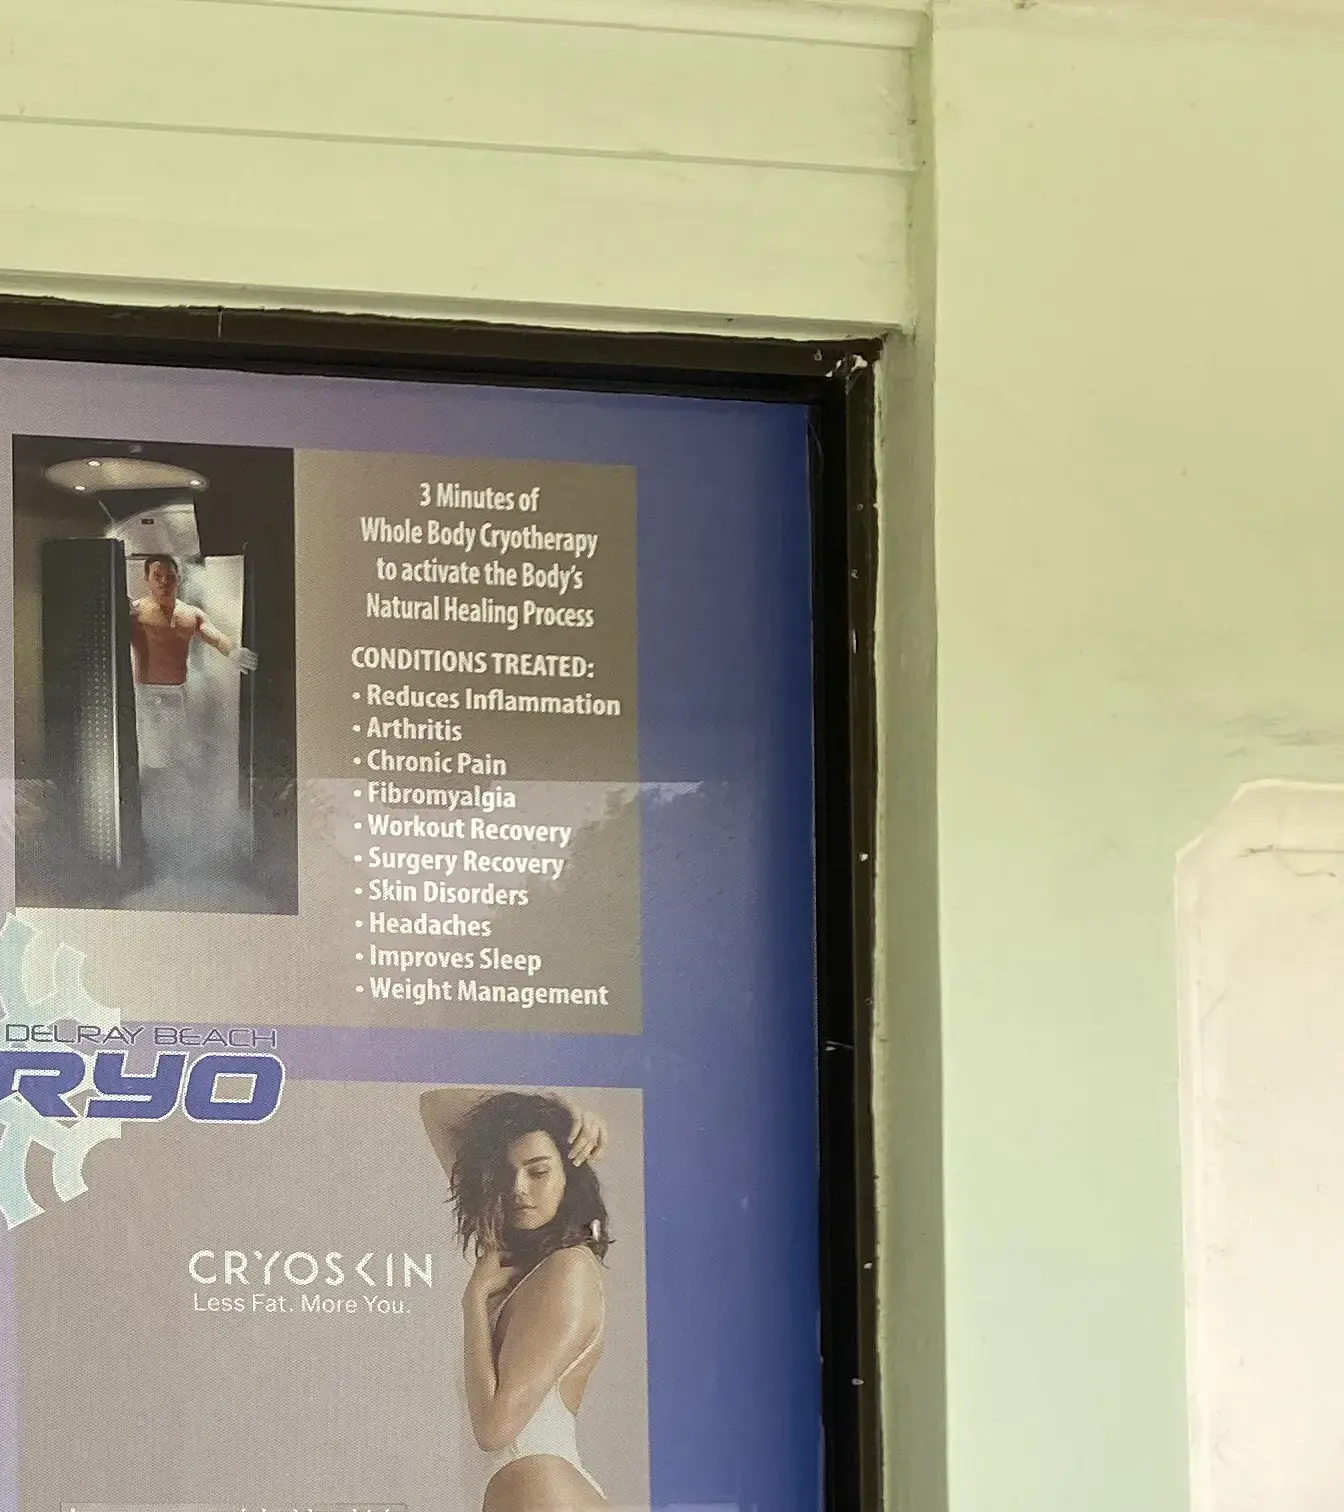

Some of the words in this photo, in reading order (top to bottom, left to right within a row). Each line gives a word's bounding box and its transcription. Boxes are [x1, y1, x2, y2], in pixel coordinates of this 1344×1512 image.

[420, 482, 431, 506] 3
[437, 482, 514, 510] Minutes
[361, 516, 422, 544] Whole
[428, 520, 475, 553] Body
[480, 522, 599, 558] Cryotherapy
[402, 558, 480, 585] activate
[484, 560, 517, 586] the
[366, 593, 439, 621] Natural
[444, 596, 519, 631] Healing
[523, 600, 594, 628] Process
[351, 646, 487, 673] CONDITIONS
[492, 653, 595, 678] TREATED:
[367, 683, 460, 710] Reduces
[465, 687, 621, 716] Inflammation
[366, 717, 462, 741] Arthritis
[367, 750, 452, 773] Chronic
[457, 752, 507, 775] Pain
[368, 781, 516, 813] Fibromyalgia
[368, 814, 465, 838] Workout
[471, 818, 572, 847] Recovery
[369, 847, 457, 876] Surgery
[463, 850, 565, 880] Recovery
[369, 879, 416, 902] Skin
[424, 881, 528, 906] Disorders
[370, 912, 492, 937] Headaches
[370, 944, 474, 972] Improves
[480, 947, 542, 975] Sleep
[370, 977, 451, 1005] Weight
[457, 979, 609, 1009] Management
[5, 1023, 145, 1045] DELRAY
[154, 1028, 277, 1048] BEACH
[189, 1250, 432, 1288] CRYOSKIN
[194, 1292, 244, 1311] Less
[252, 1294, 293, 1312] Fat.
[302, 1294, 358, 1312] More
[363, 1295, 411, 1314] You.
